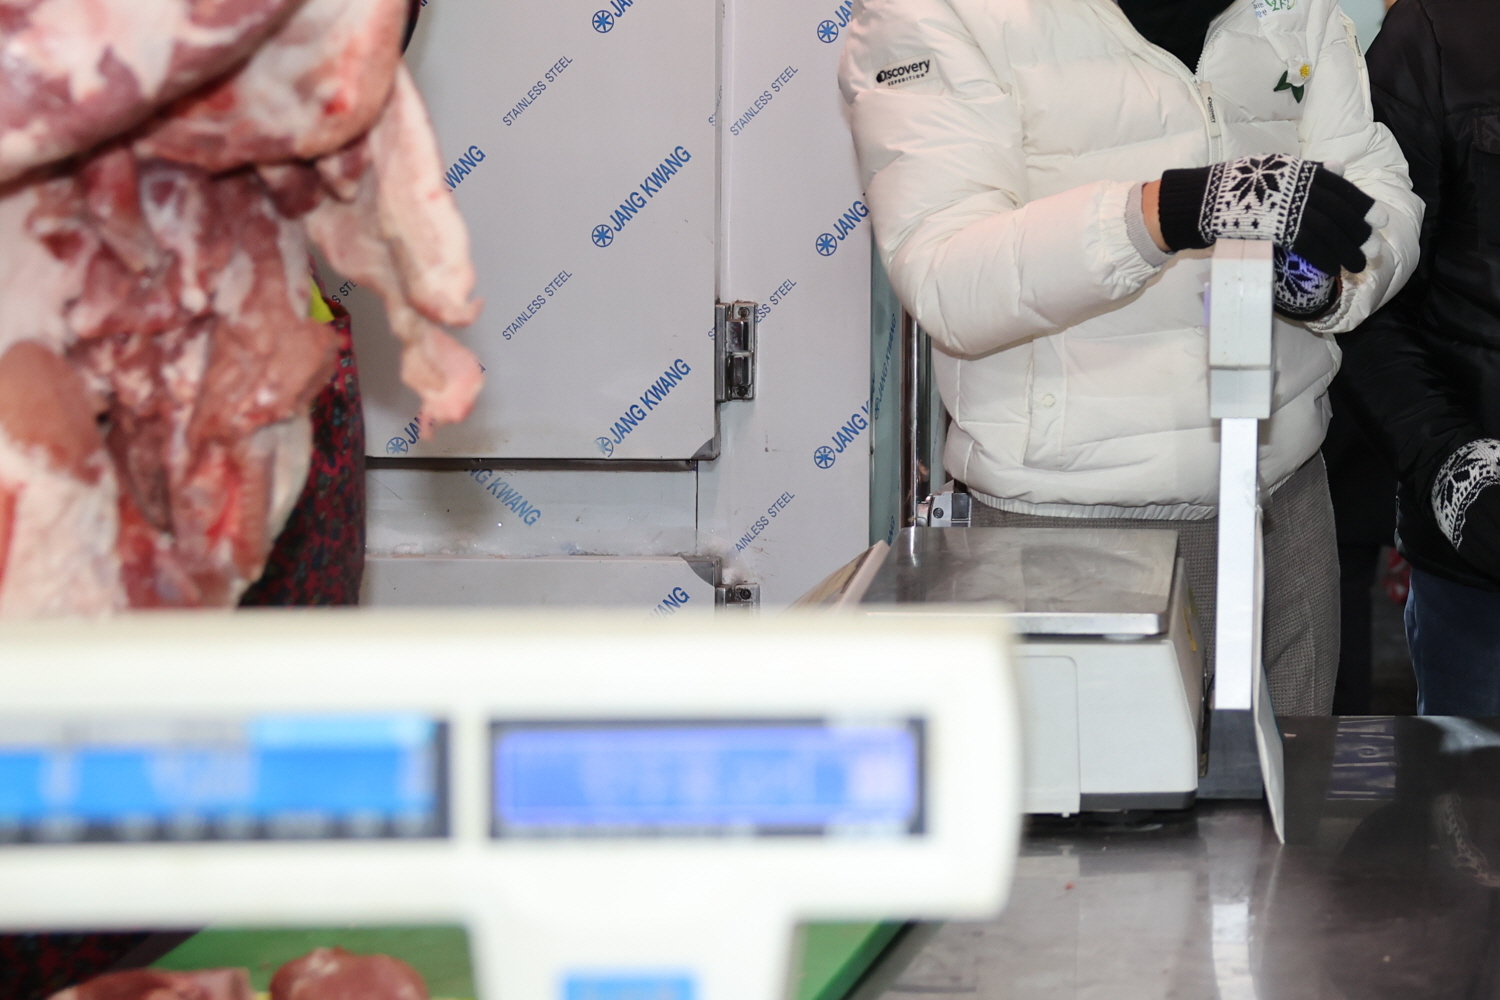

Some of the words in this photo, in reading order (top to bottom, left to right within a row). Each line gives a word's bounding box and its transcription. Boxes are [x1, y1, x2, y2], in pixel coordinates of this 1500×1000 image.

[502, 80, 547, 127] STAINLESS
[543, 56, 573, 85] STEEL
[730, 90, 773, 136] STAINLESS
[771, 65, 799, 92] STEEL
[444, 145, 486, 192] WANG
[608, 191, 648, 233] JANG
[640, 145, 692, 199] KWANG
[833, 200, 870, 241] JANG
[502, 295, 547, 341] STAINLESS
[543, 269, 573, 299] STEEL
[769, 278, 797, 305] STEEL
[608, 403, 648, 446] JANG
[638, 358, 692, 413] KWANG
[831, 413, 868, 453] JANG
[486, 477, 541, 527] KWANG
[735, 515, 770, 552] AINLESS
[767, 491, 795, 518] STEEL
